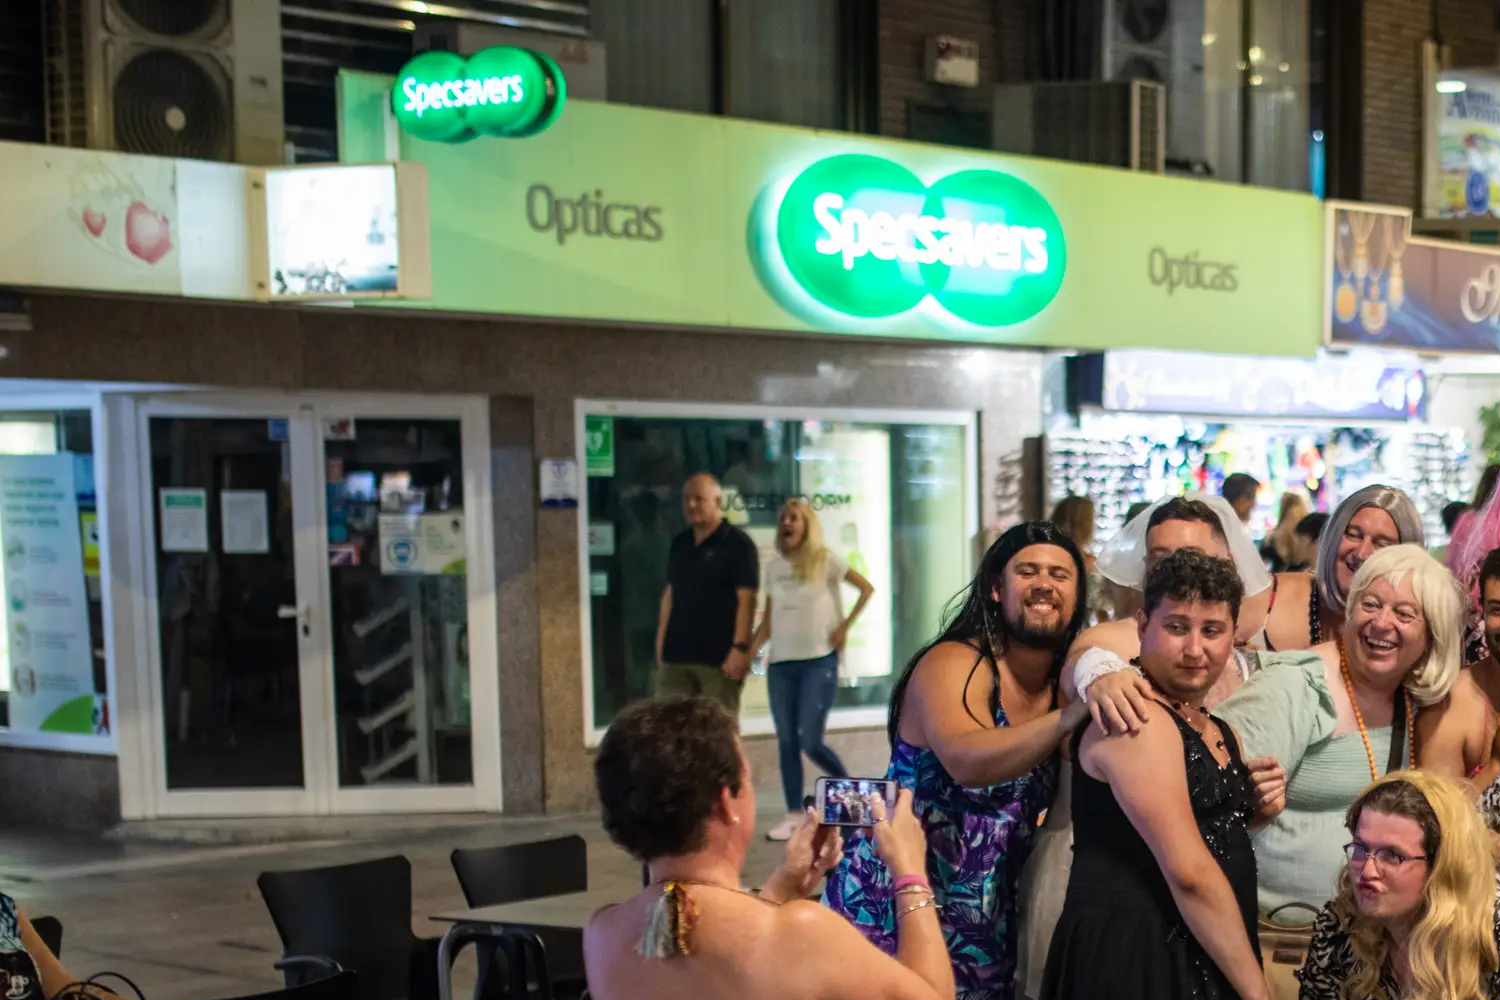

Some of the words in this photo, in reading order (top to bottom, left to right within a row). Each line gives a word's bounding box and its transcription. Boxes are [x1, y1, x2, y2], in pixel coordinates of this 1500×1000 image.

[402, 75, 523, 118] Specsavers
[526, 184, 664, 246] Opticas
[813, 192, 1048, 274] Specsavers
[1148, 247, 1239, 297] Opticas
